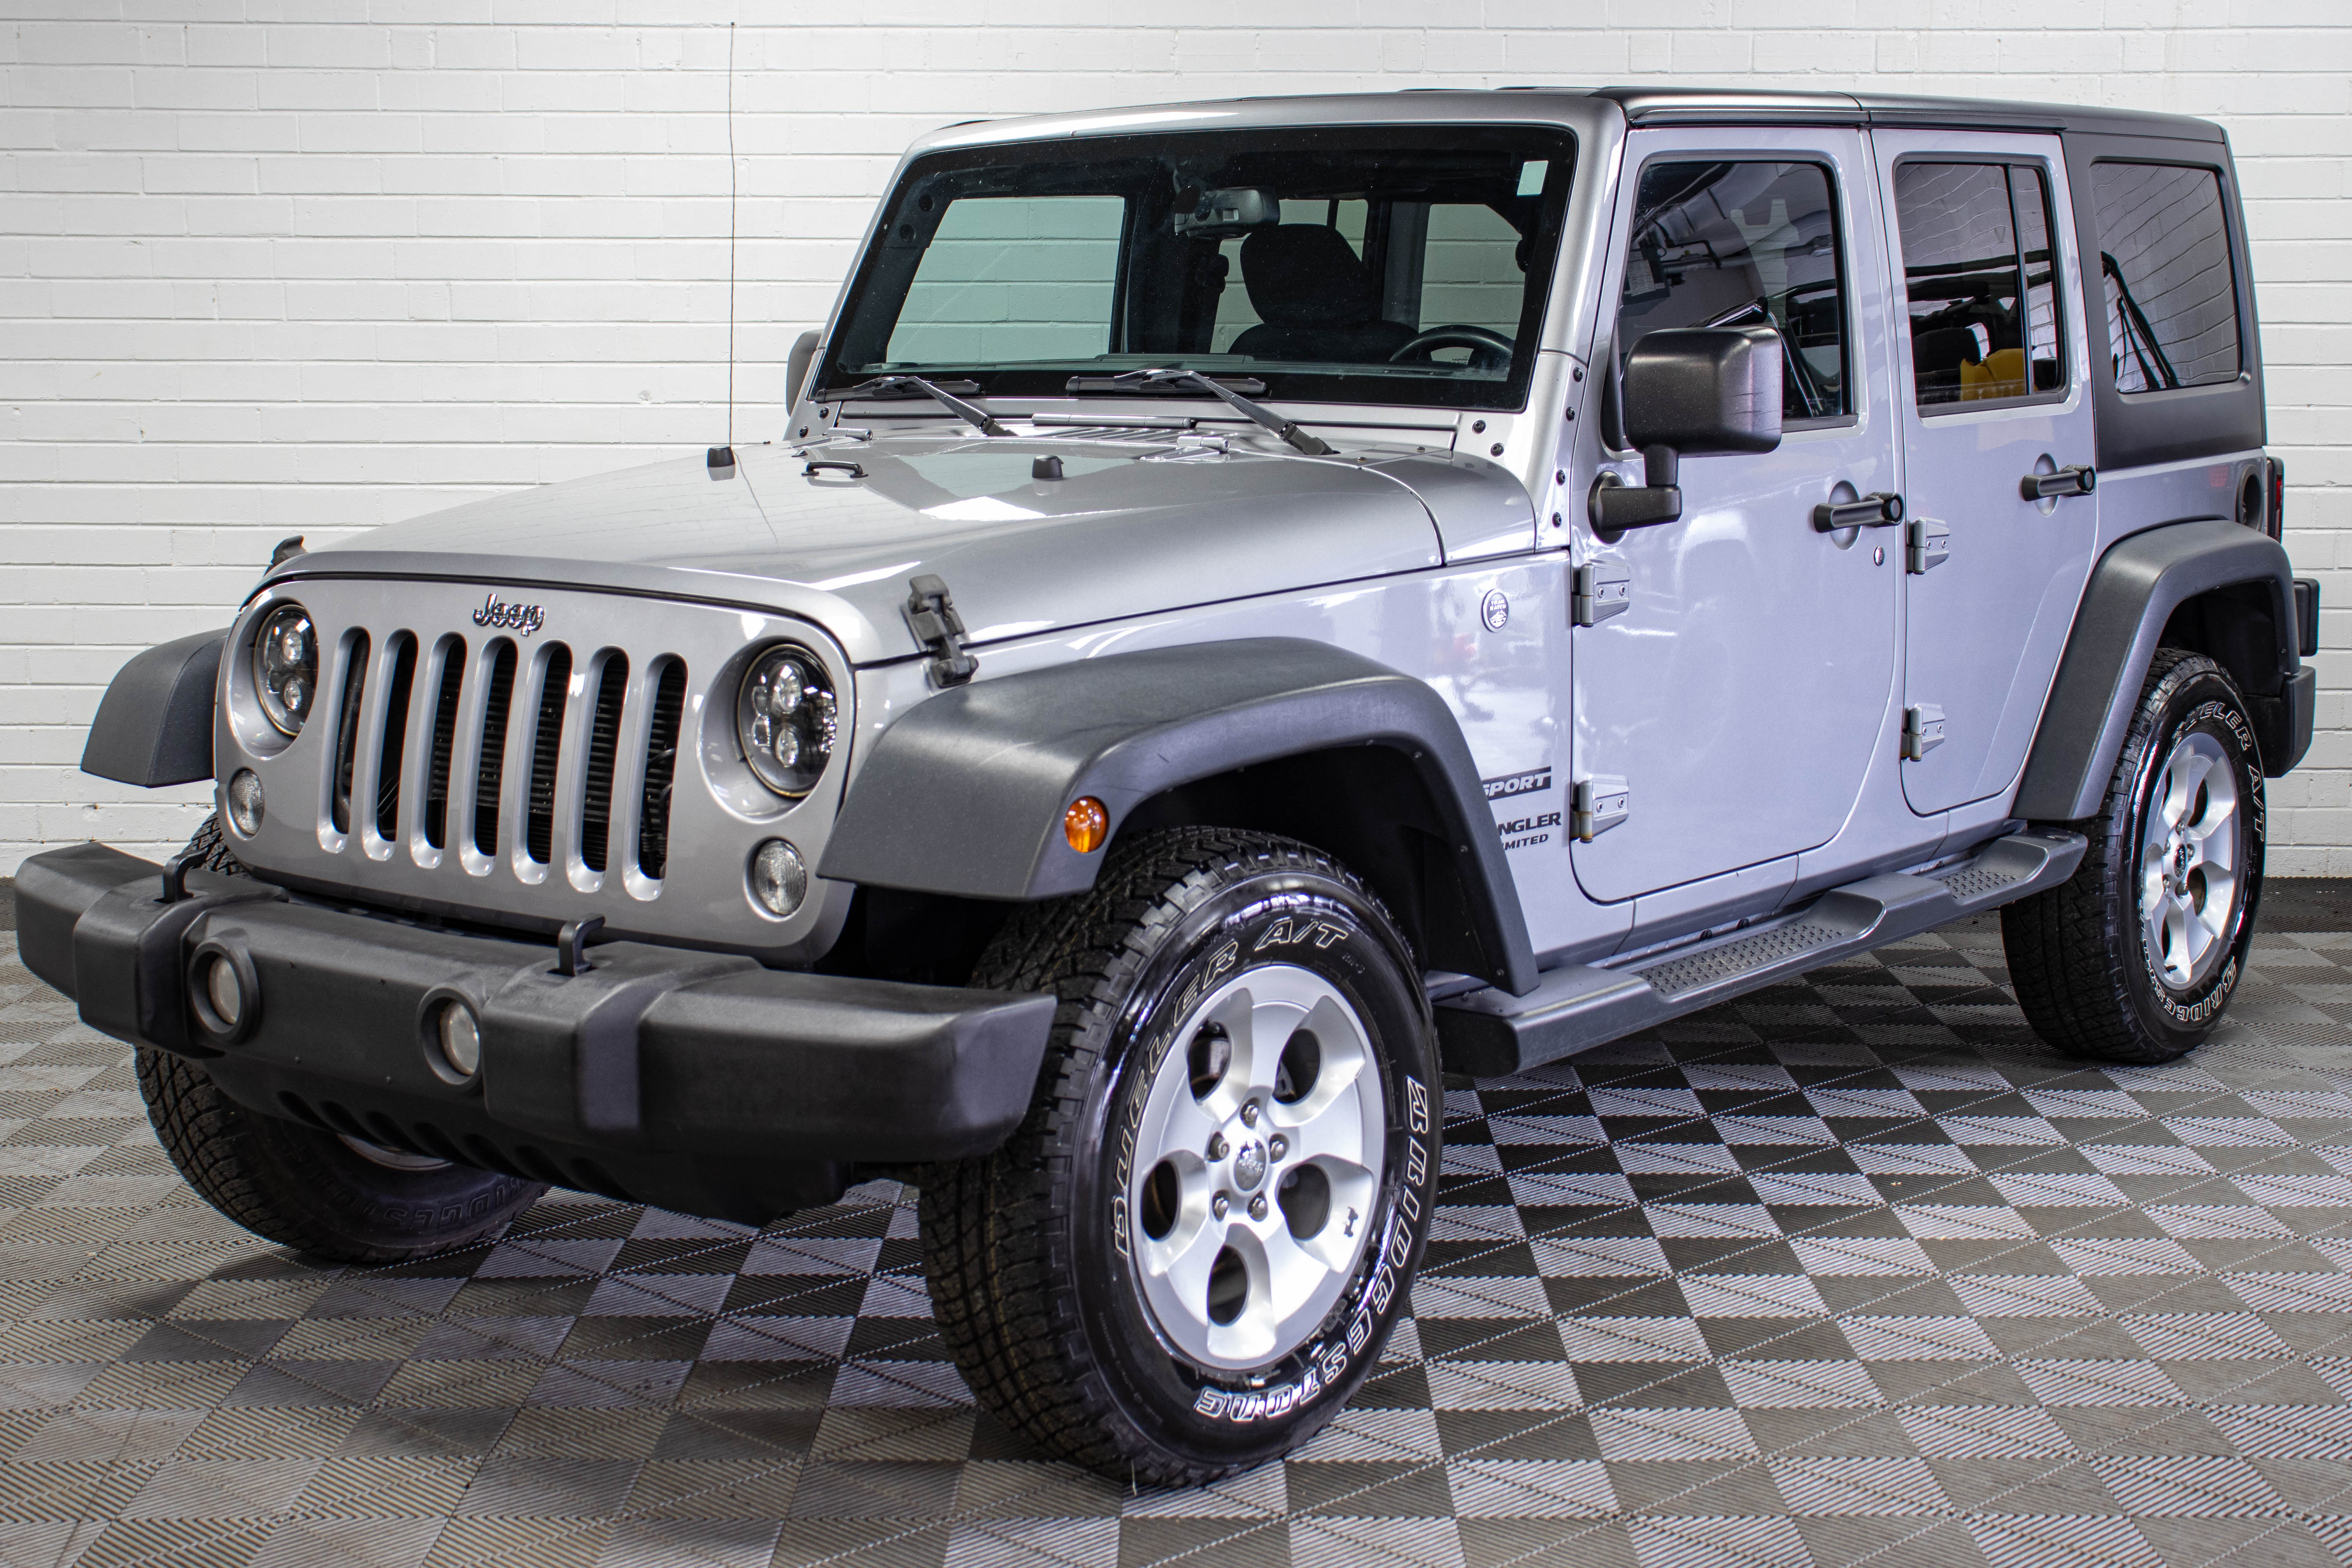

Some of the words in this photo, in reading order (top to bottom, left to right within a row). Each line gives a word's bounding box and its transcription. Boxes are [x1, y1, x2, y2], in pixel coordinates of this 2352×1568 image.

[473, 593, 544, 637] Jeep
[1498, 811, 1562, 836] NGLER
[2247, 764, 2265, 841] A/T
[1502, 833, 1549, 850] MITED
[1114, 940, 1238, 1256] DUELER
[1254, 918, 1349, 952] A/T
[1194, 1075, 1429, 1422] BRIDGESTONE
